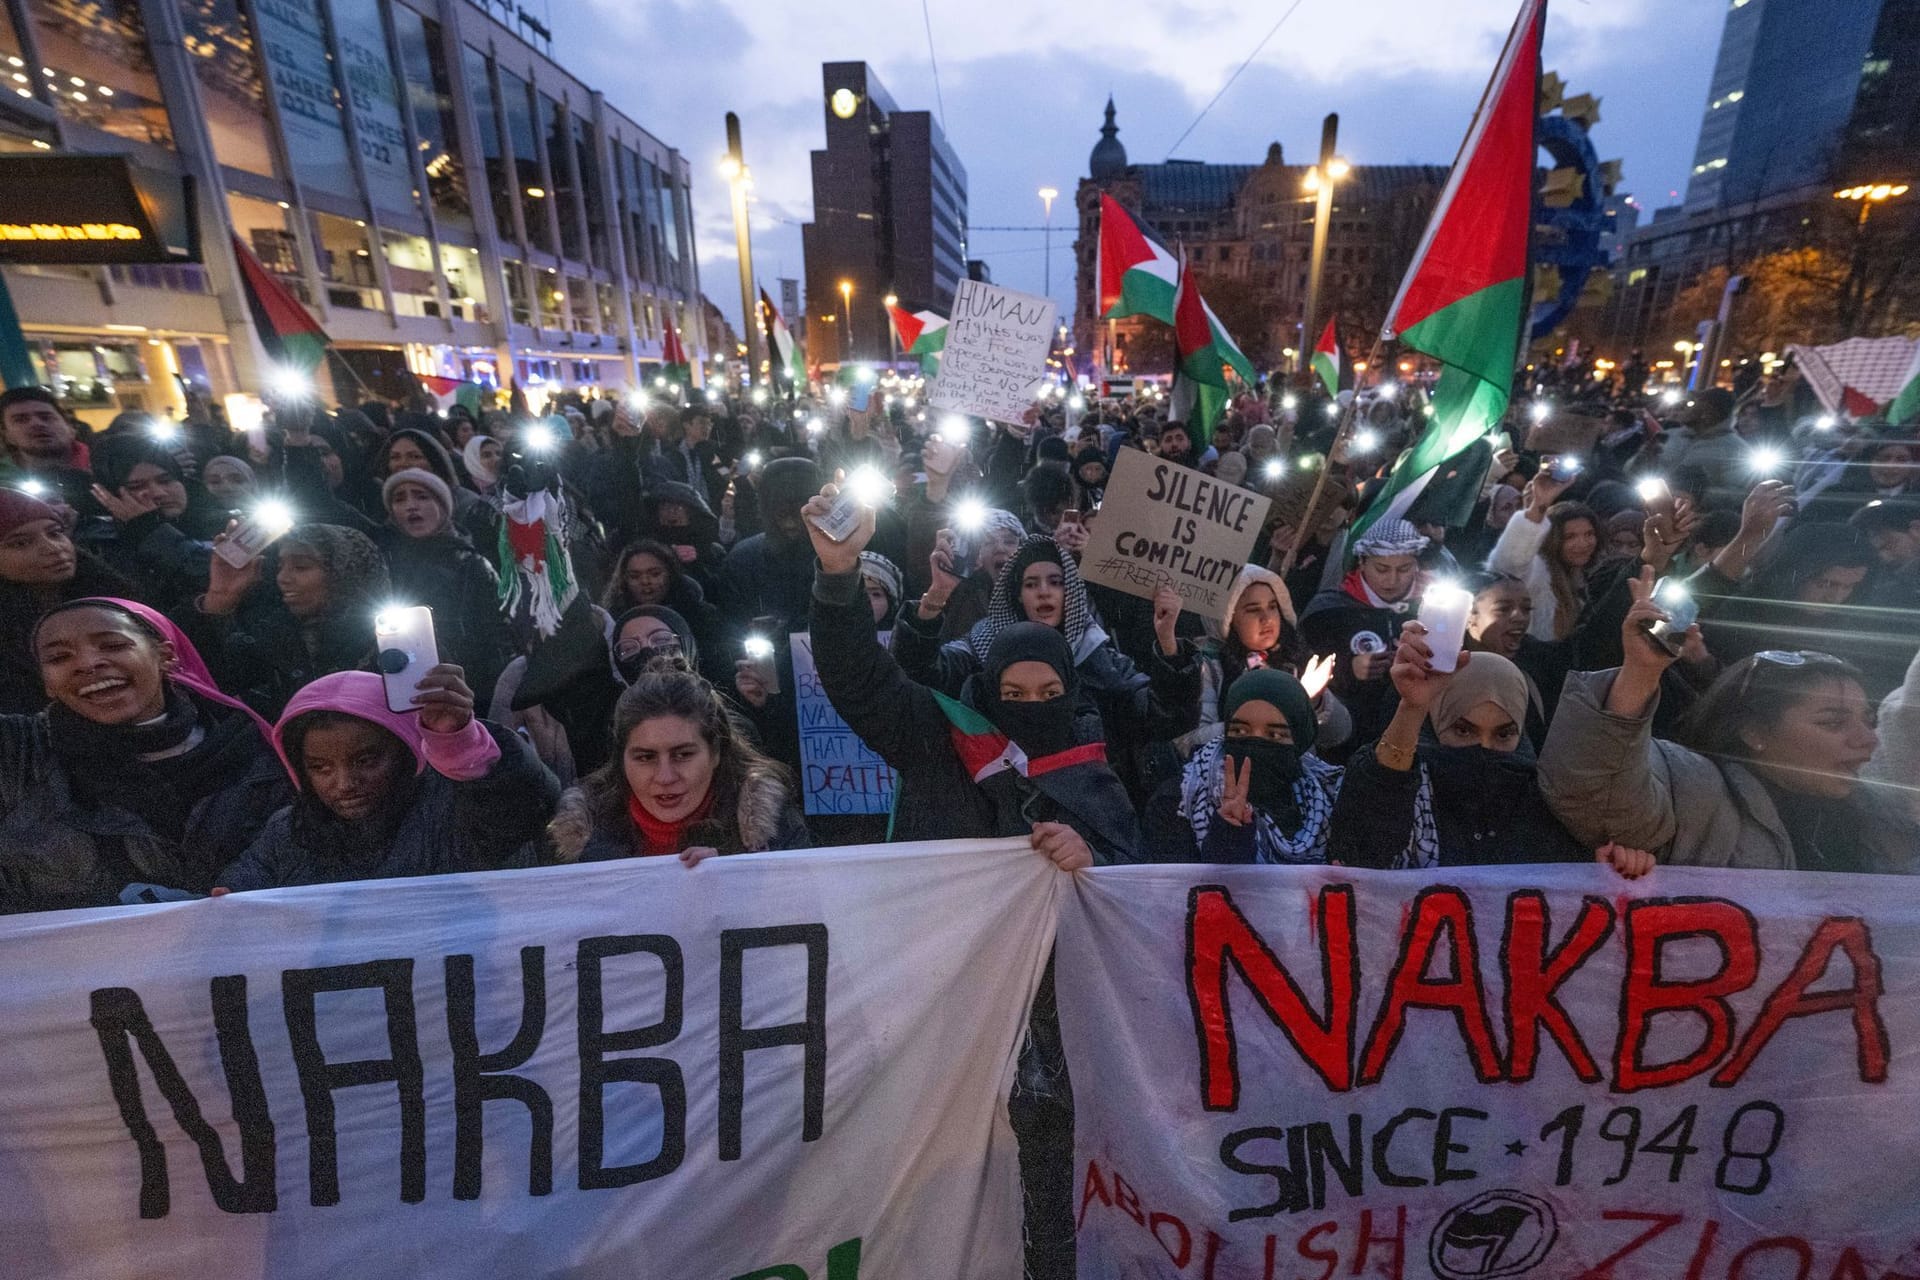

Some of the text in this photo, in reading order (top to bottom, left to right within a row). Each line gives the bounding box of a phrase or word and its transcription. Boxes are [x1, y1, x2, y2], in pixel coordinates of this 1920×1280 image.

[351, 88, 372, 112] ES
[353, 114, 404, 149] AHRES
[361, 137, 393, 166] 022
[955, 279, 1047, 326] HUMAN
[1146, 464, 1255, 533] SILENCE
[1171, 516, 1197, 545] IS
[1115, 531, 1244, 592] COMPLICITY
[801, 736, 848, 761] THAT
[806, 765, 894, 793] DEATH
[1185, 883, 1891, 1112] NAKBA
[89, 922, 828, 1219] NAKBA
[1219, 1099, 1786, 1222] SINCE 1948
